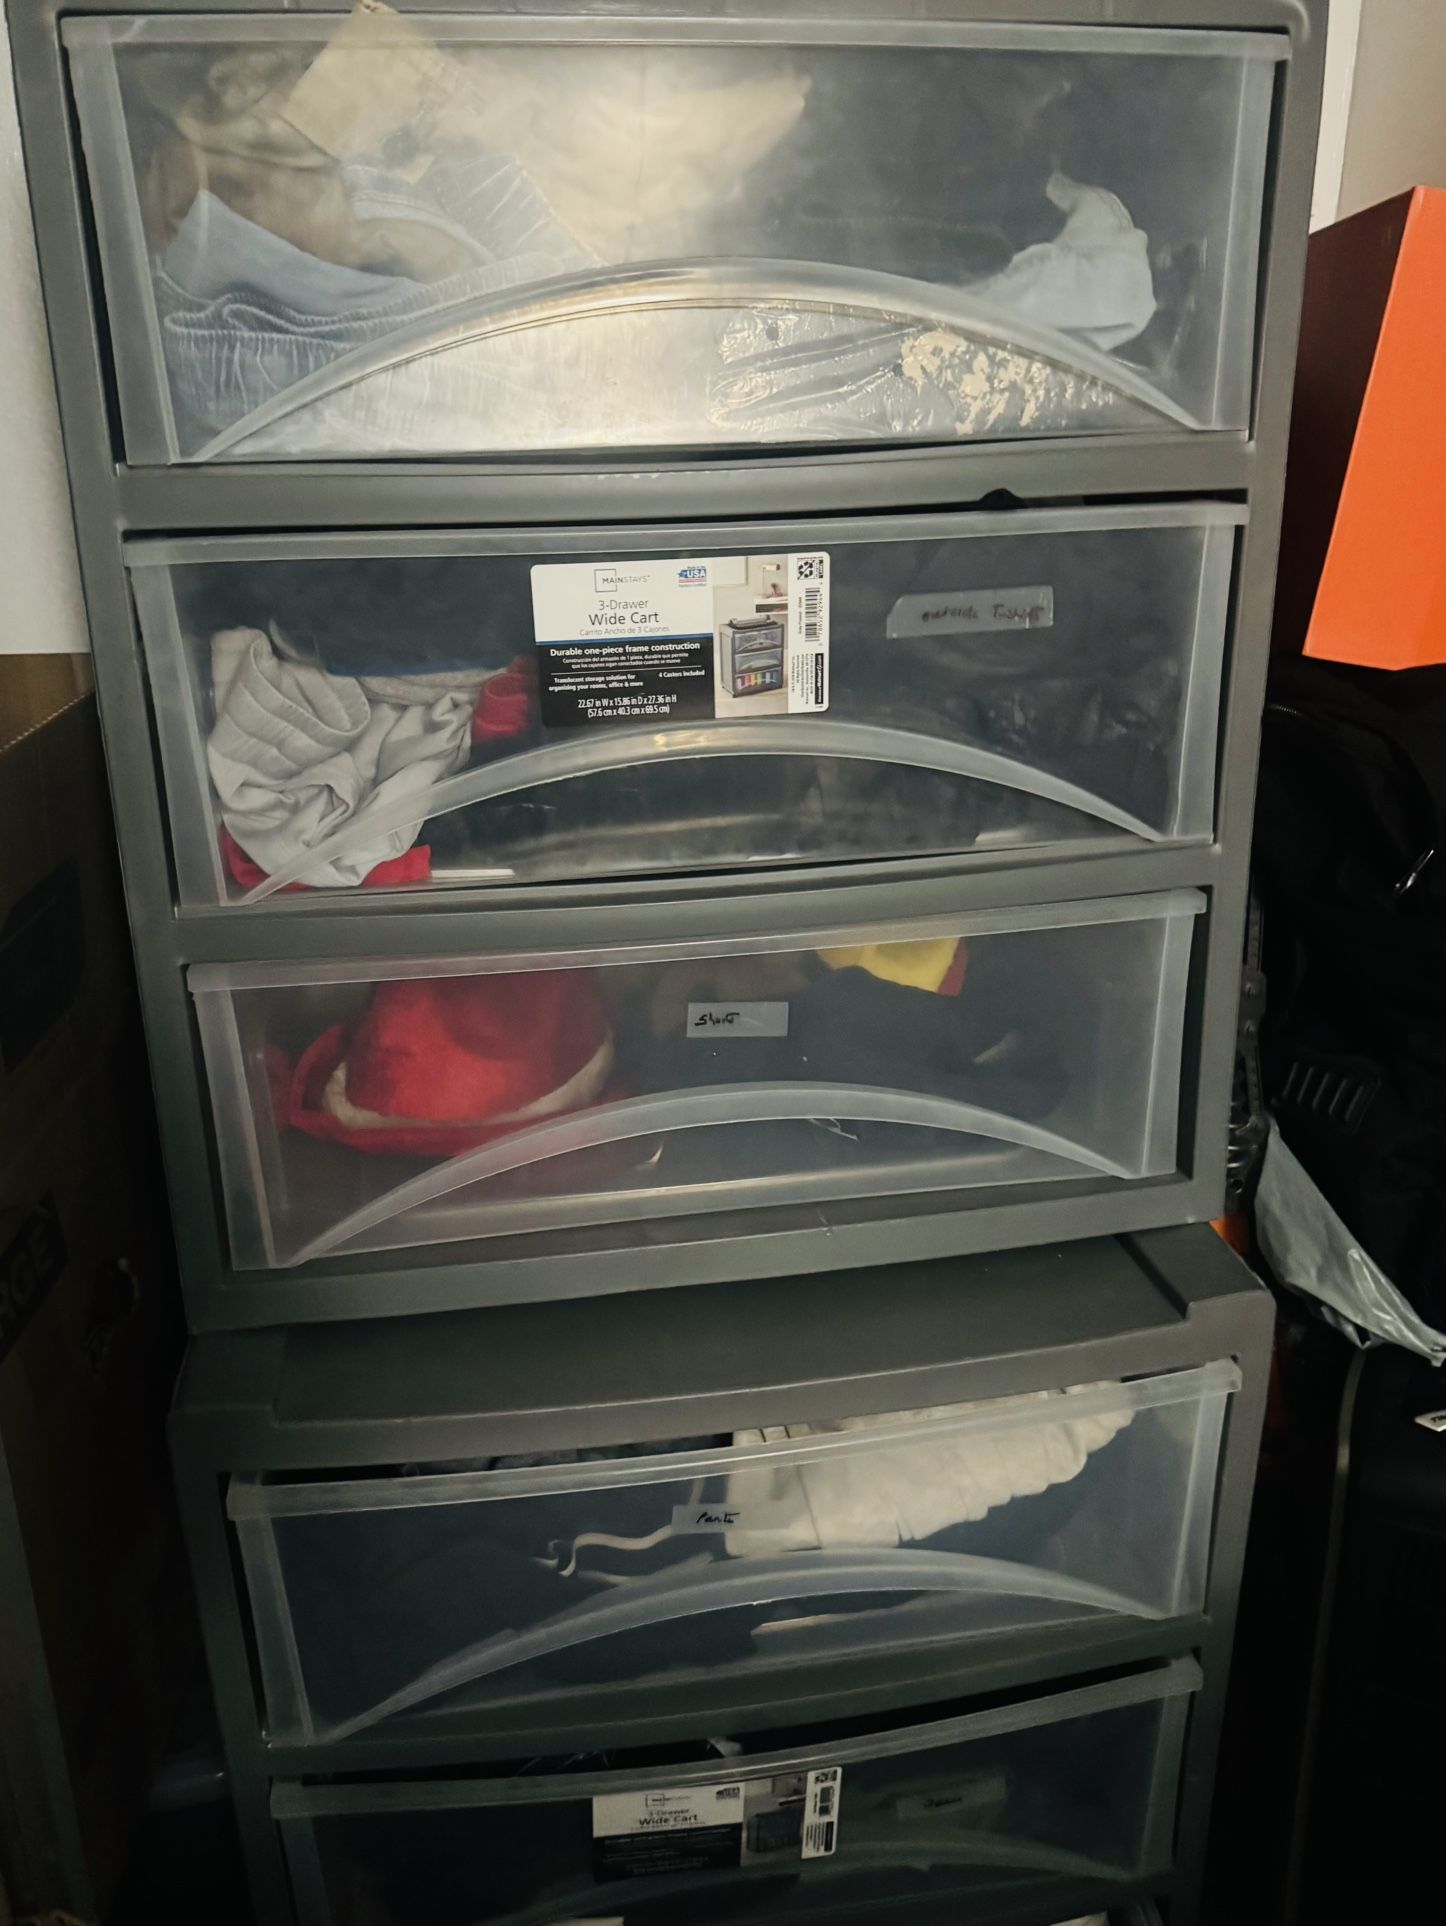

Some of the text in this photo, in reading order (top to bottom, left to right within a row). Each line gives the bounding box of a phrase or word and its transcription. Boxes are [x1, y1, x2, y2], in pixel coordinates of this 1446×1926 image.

[602, 575, 650, 584] MAINSTAYS
[687, 570, 706, 578] USA
[598, 600, 648, 611] 3-Drawer
[588, 612, 660, 626] Wide Cart
[550, 648, 582, 656] Durable
[584, 646, 624, 655] one-piece
[651, 642, 700, 651] construction
[578, 699, 594, 708] 22.67
[595, 699, 601, 707] in
[601, 698, 609, 707] W
[614, 697, 630, 706] 15.86
[638, 696, 643, 704] D
[648, 695, 664, 704] 27.36
[665, 695, 671, 703] in
[672, 694, 677, 703] H
[588, 708, 603, 718] (57.6
[618, 707, 630, 715] 40.3
[645, 705, 658, 714] 69.5
[659, 704, 670, 714] cm)
[639, 1816, 670, 1825] Wide
